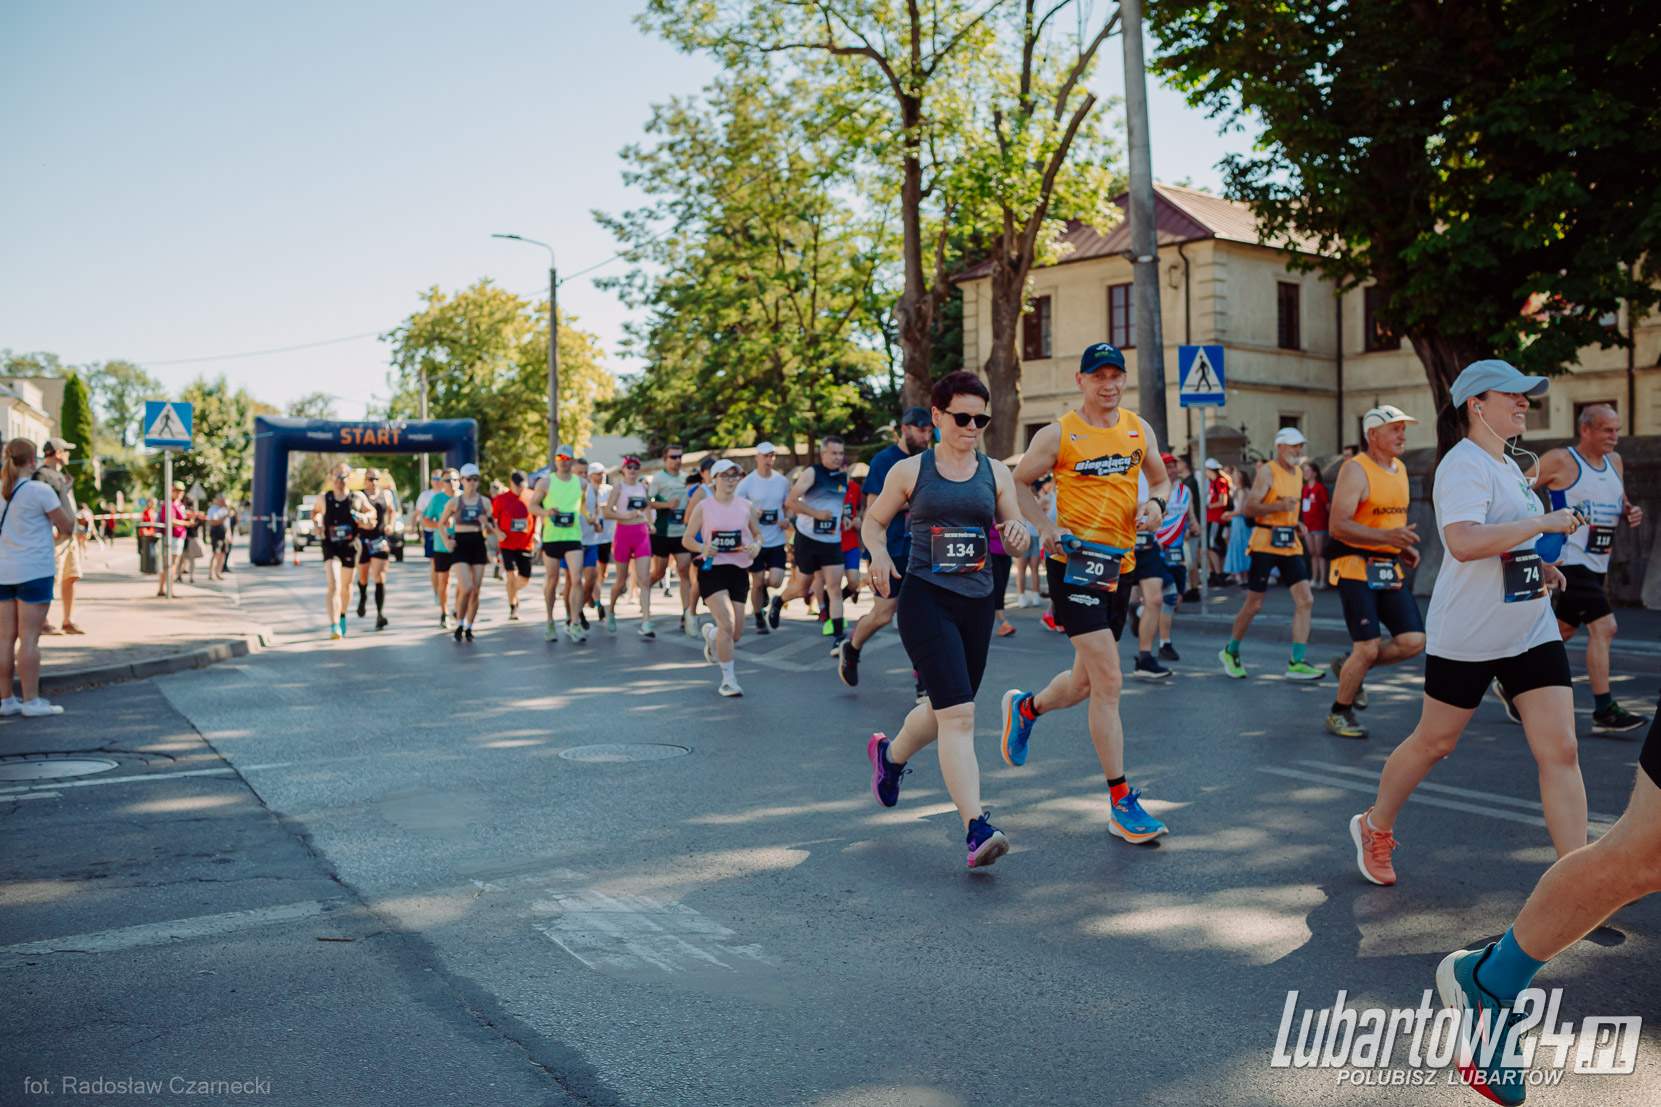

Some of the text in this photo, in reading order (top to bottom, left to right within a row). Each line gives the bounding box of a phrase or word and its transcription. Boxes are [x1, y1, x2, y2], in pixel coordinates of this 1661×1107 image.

[340, 427, 402, 446] START
[945, 543, 975, 557] 134
[1084, 560, 1105, 576] 20
[1523, 566, 1540, 584] 74
